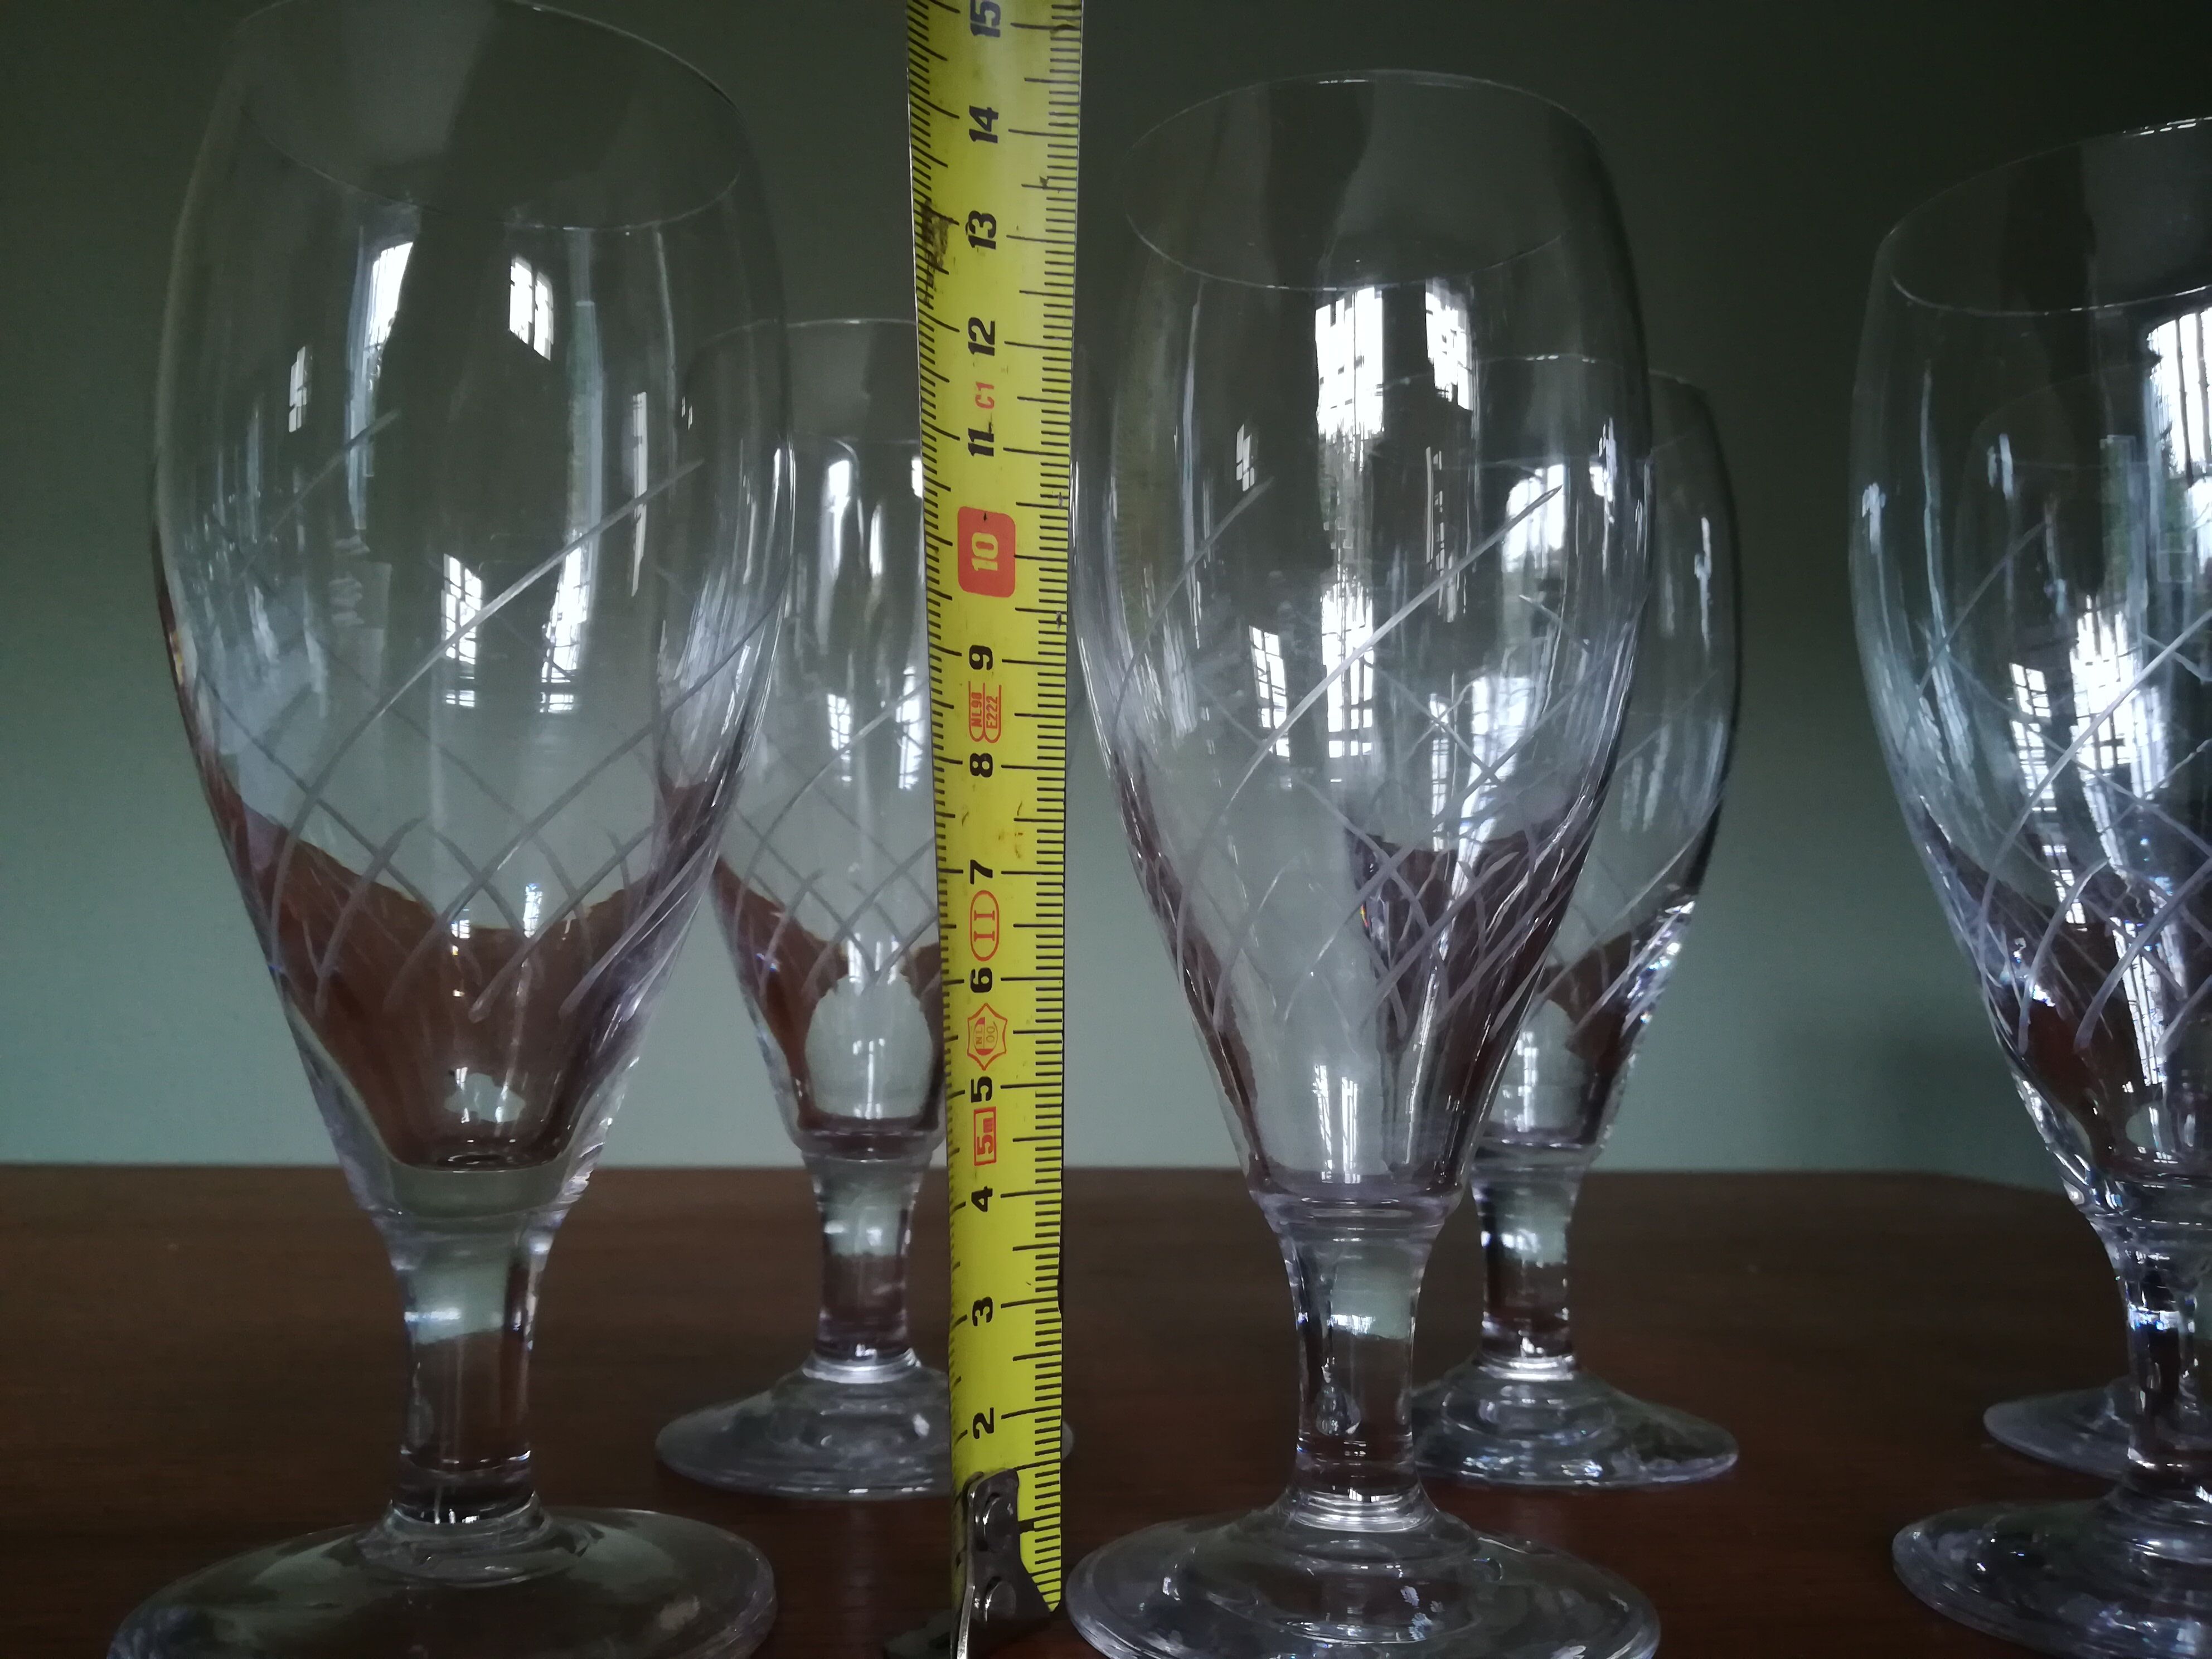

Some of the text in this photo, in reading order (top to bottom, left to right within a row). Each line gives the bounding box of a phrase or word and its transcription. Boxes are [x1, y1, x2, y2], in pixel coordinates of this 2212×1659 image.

[970, 0, 1001, 37] 15
[969, 105, 998, 143] 14
[968, 211, 996, 249] 13
[968, 317, 995, 356] 12
[975, 382, 995, 409] C1
[968, 428, 994, 457] 11
[972, 532, 998, 571] 10
[969, 645, 993, 670] 9
[969, 753, 993, 778] 8
[970, 860, 993, 885] 7
[970, 967, 993, 992] 6
[971, 1076, 993, 1103] 5
[971, 1186, 993, 1212] 4
[972, 1296, 993, 1325] 3
[972, 1407, 995, 1439] 2
